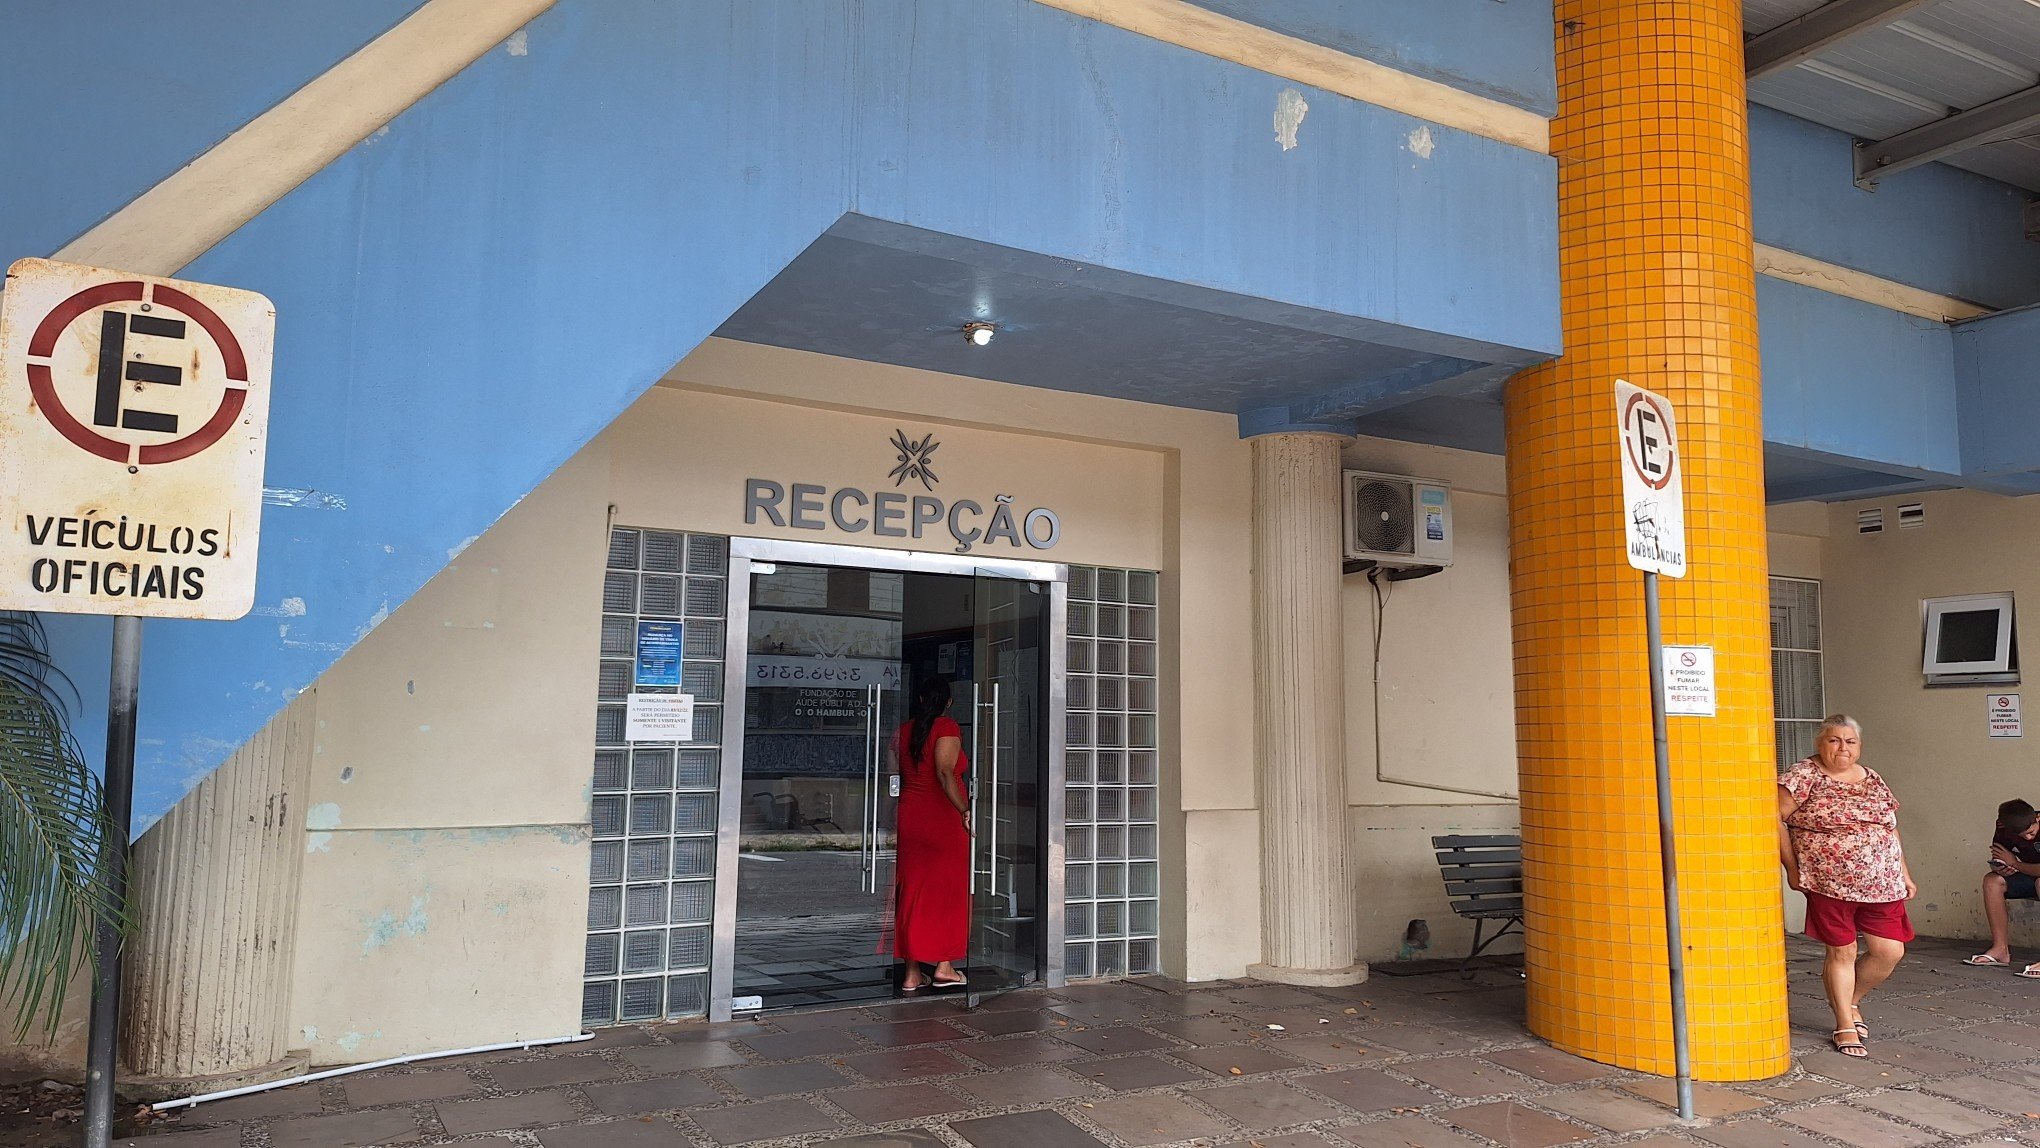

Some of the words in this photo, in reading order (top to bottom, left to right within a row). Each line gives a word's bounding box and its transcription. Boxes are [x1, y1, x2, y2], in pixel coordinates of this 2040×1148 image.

[94, 311, 186, 433] E
[1637, 409, 1661, 475] E
[27, 510, 219, 556] VEÍCULOS
[745, 478, 1061, 552] RECEPÇÃO
[32, 558, 205, 600] OFICIAIS
[800, 689, 844, 699] FUNDAÇÃO
